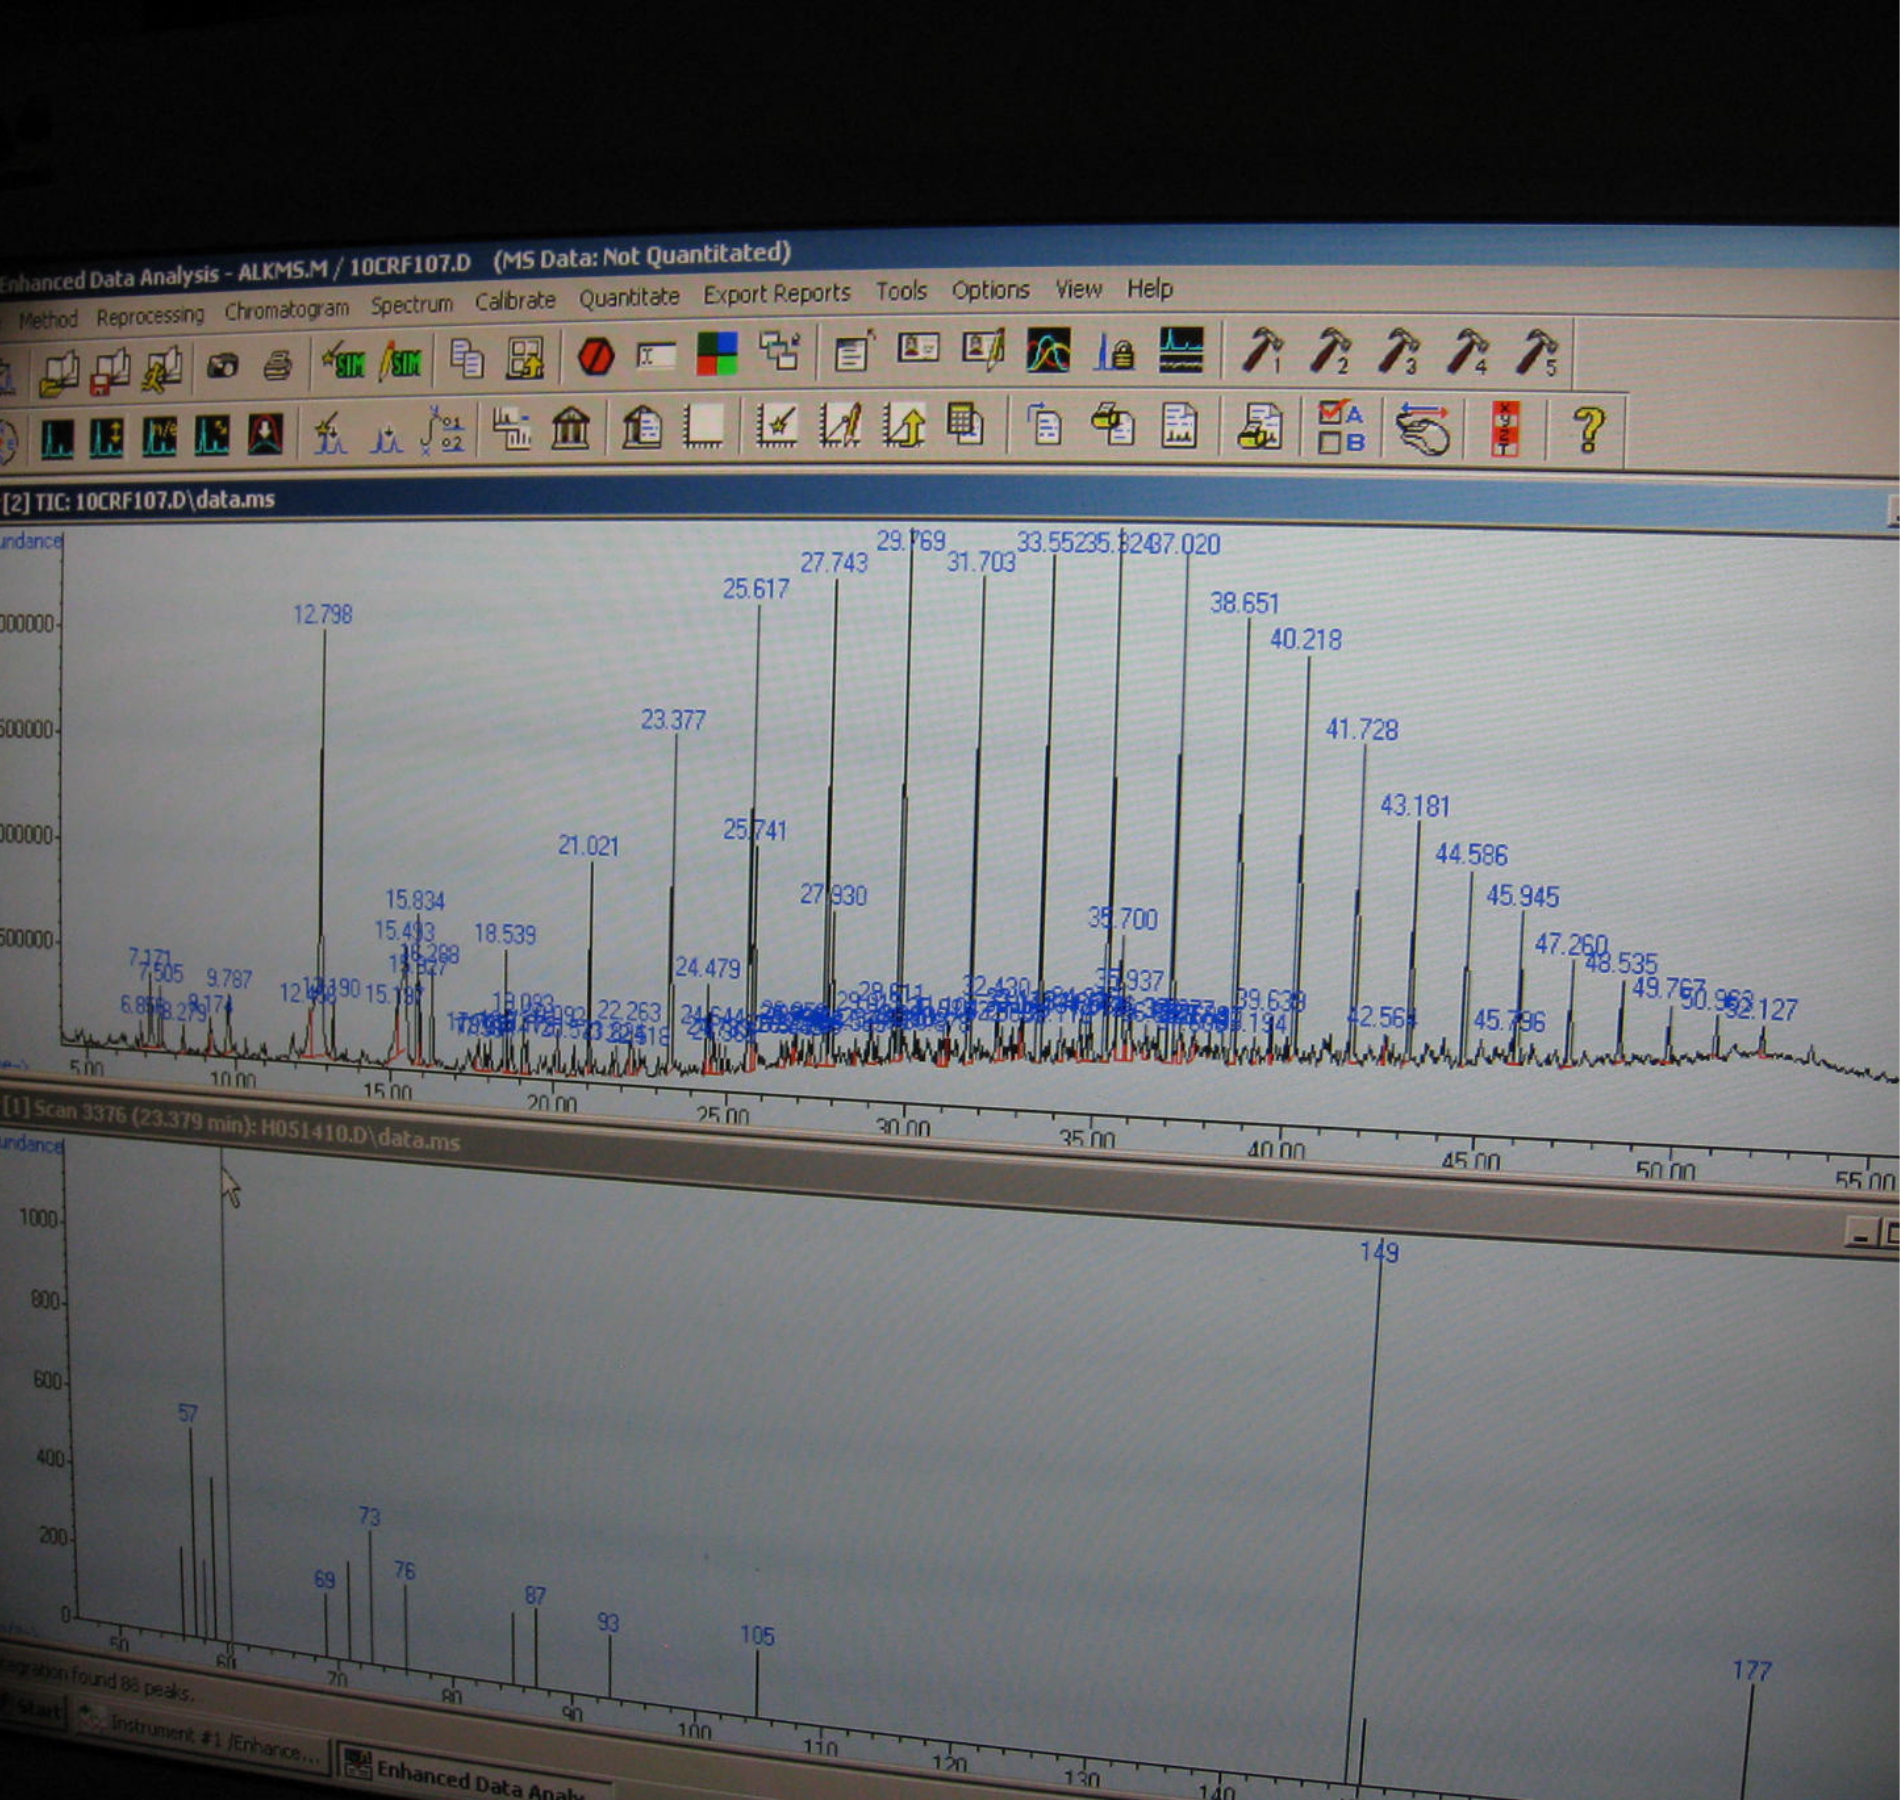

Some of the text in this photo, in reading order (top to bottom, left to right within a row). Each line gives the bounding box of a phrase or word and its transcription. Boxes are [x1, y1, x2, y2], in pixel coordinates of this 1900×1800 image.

[0, 270, 85, 294] Enhanced
[90, 270, 135, 290] Data
[140, 264, 219, 288] Analysis
[238, 260, 328, 282] ALKMS.M
[351, 253, 471, 277] 10CRF107.D
[494, 249, 534, 275] (MS
[541, 248, 598, 269] Data:
[603, 245, 641, 266] Not
[647, 239, 791, 268] Quantitated)
[579, 286, 680, 310] Quantitate
[704, 283, 851, 308] Export Reports
[876, 280, 928, 301] Tools
[952, 279, 1031, 303] Options
[1056, 278, 1103, 299] View
[1128, 277, 1174, 301] Help
[226, 300, 349, 322] Chromatogram
[371, 294, 453, 317] Spectrum
[476, 290, 556, 312] Calibrate
[19, 309, 78, 331] Method
[97, 304, 204, 328] Reprocessing
[335, 352, 366, 377] SIM
[392, 351, 423, 376] SIM
[1275, 357, 1280, 374] 1
[1337, 358, 1349, 375] 2
[1405, 358, 1417, 375] 3
[1475, 359, 1487, 375] 4
[1546, 360, 1557, 377] 5
[1345, 406, 1363, 424] A
[1347, 434, 1366, 451] B
[3, 489, 276, 516] [2] TIC: 10CRF107.D\data.ms
[1017, 530, 1088, 554] 33.552
[800, 551, 869, 574] 27.743
[947, 551, 1016, 574] 31.703
[723, 578, 790, 600] 25.617
[294, 603, 353, 626] 12.798
[1210, 591, 1280, 615] 38.651
[1270, 627, 1342, 651] 40.218
[641, 708, 707, 731] 23.377
[1326, 718, 1399, 742] 41.728
[1380, 794, 1450, 818] 43.181
[723, 818, 788, 841] 25.741
[558, 834, 620, 857] 21.021
[1435, 842, 1509, 867] 44.586
[386, 889, 445, 911] 15.834
[1486, 884, 1560, 909] 45.945
[1088, 906, 1158, 931] 35.700
[475, 923, 537, 946] 18.539
[1534, 933, 1608, 957] 47.260
[675, 956, 742, 980] 24.479
[1584, 951, 1659, 976] 48.535
[206, 967, 253, 989] 9.787
[597, 999, 662, 1023] 22.263
[3, 1093, 461, 1153] [1] Scan 3376 (23.379 min): H051410.D\data.ms
[20, 1207, 58, 1228] 1000
[1361, 1241, 1400, 1264] 149
[31, 1289, 60, 1310] 800
[34, 1370, 63, 1391] 600
[178, 1403, 198, 1423] 57
[37, 1449, 65, 1469] 400
[359, 1506, 381, 1526] 73
[40, 1526, 68, 1546] 200
[314, 1570, 336, 1590] 69
[394, 1560, 416, 1581] 76
[525, 1586, 547, 1606] 87
[61, 1605, 71, 1624] 0
[597, 1612, 620, 1633] 93
[741, 1624, 776, 1647] 105
[71, 1664, 117, 1690] found
[1733, 1660, 1773, 1683] 177
[112, 1713, 194, 1744] Instrument
[201, 1730, 223, 1748] #1
[377, 1760, 470, 1791] Enhanced
[476, 1774, 524, 1799] Data
